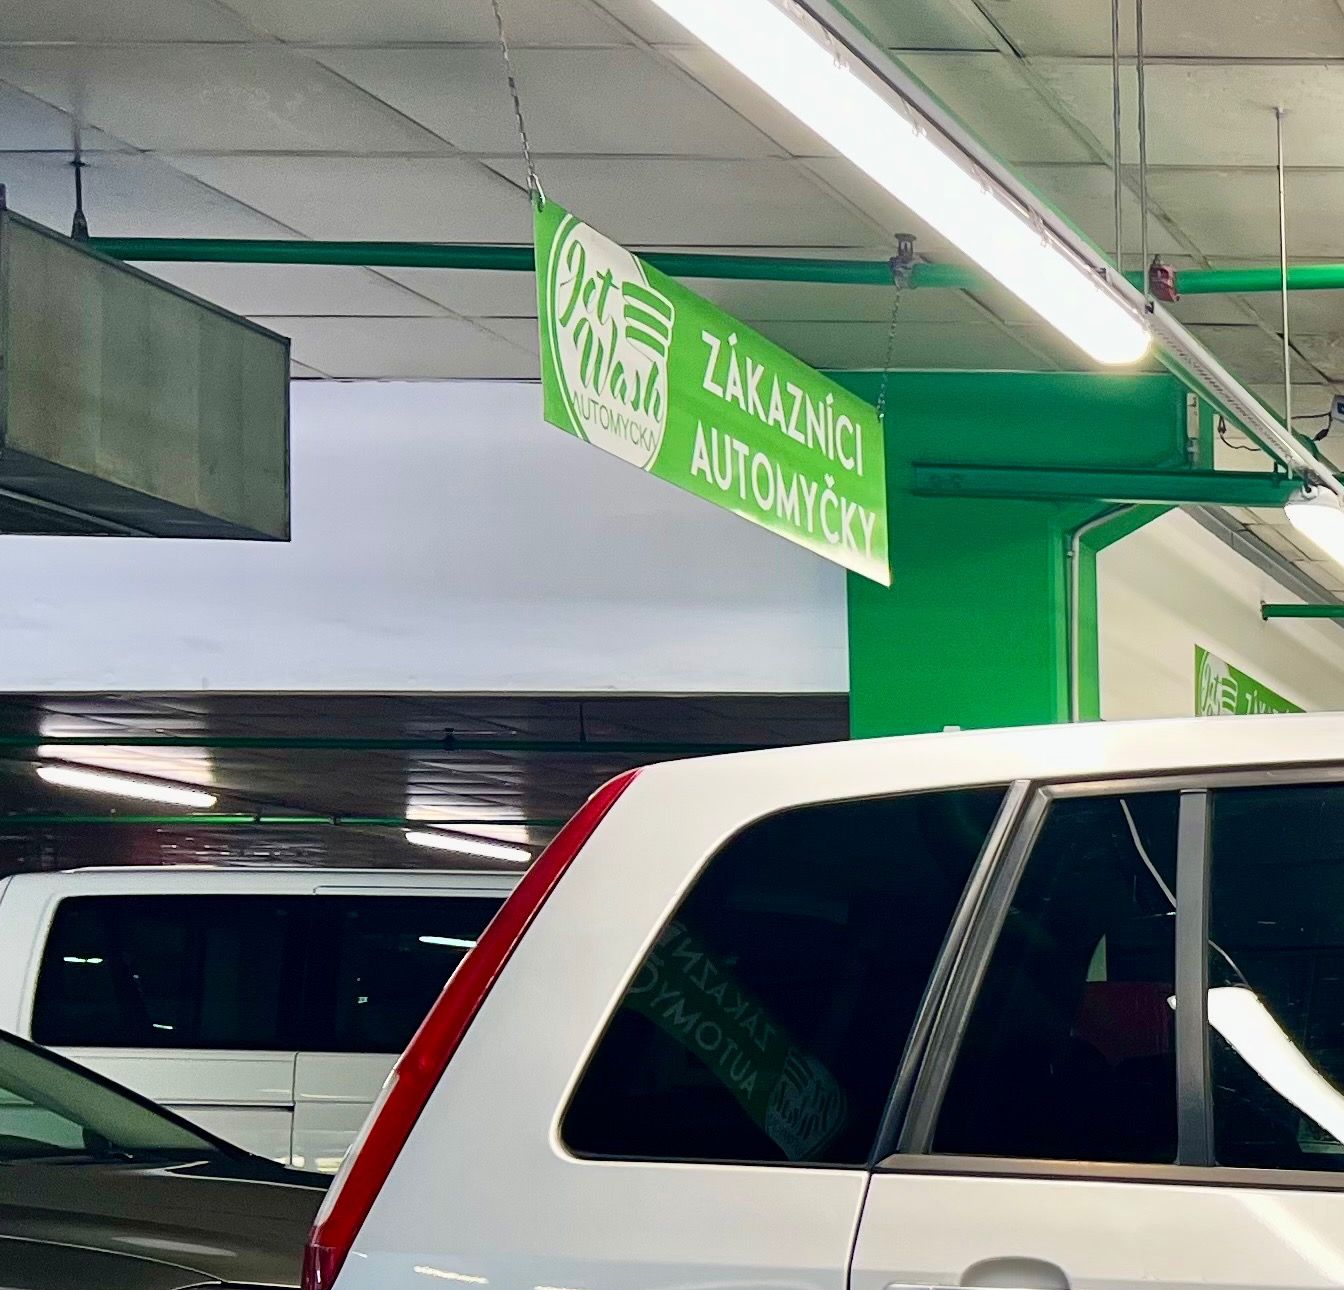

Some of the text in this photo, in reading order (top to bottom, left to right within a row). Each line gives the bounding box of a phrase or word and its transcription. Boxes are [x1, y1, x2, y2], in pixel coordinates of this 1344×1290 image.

[573, 317, 663, 424] Wash
[701, 330, 864, 477] ZÁKAZNÍCI
[691, 419, 877, 559] AUTOMYČKY
